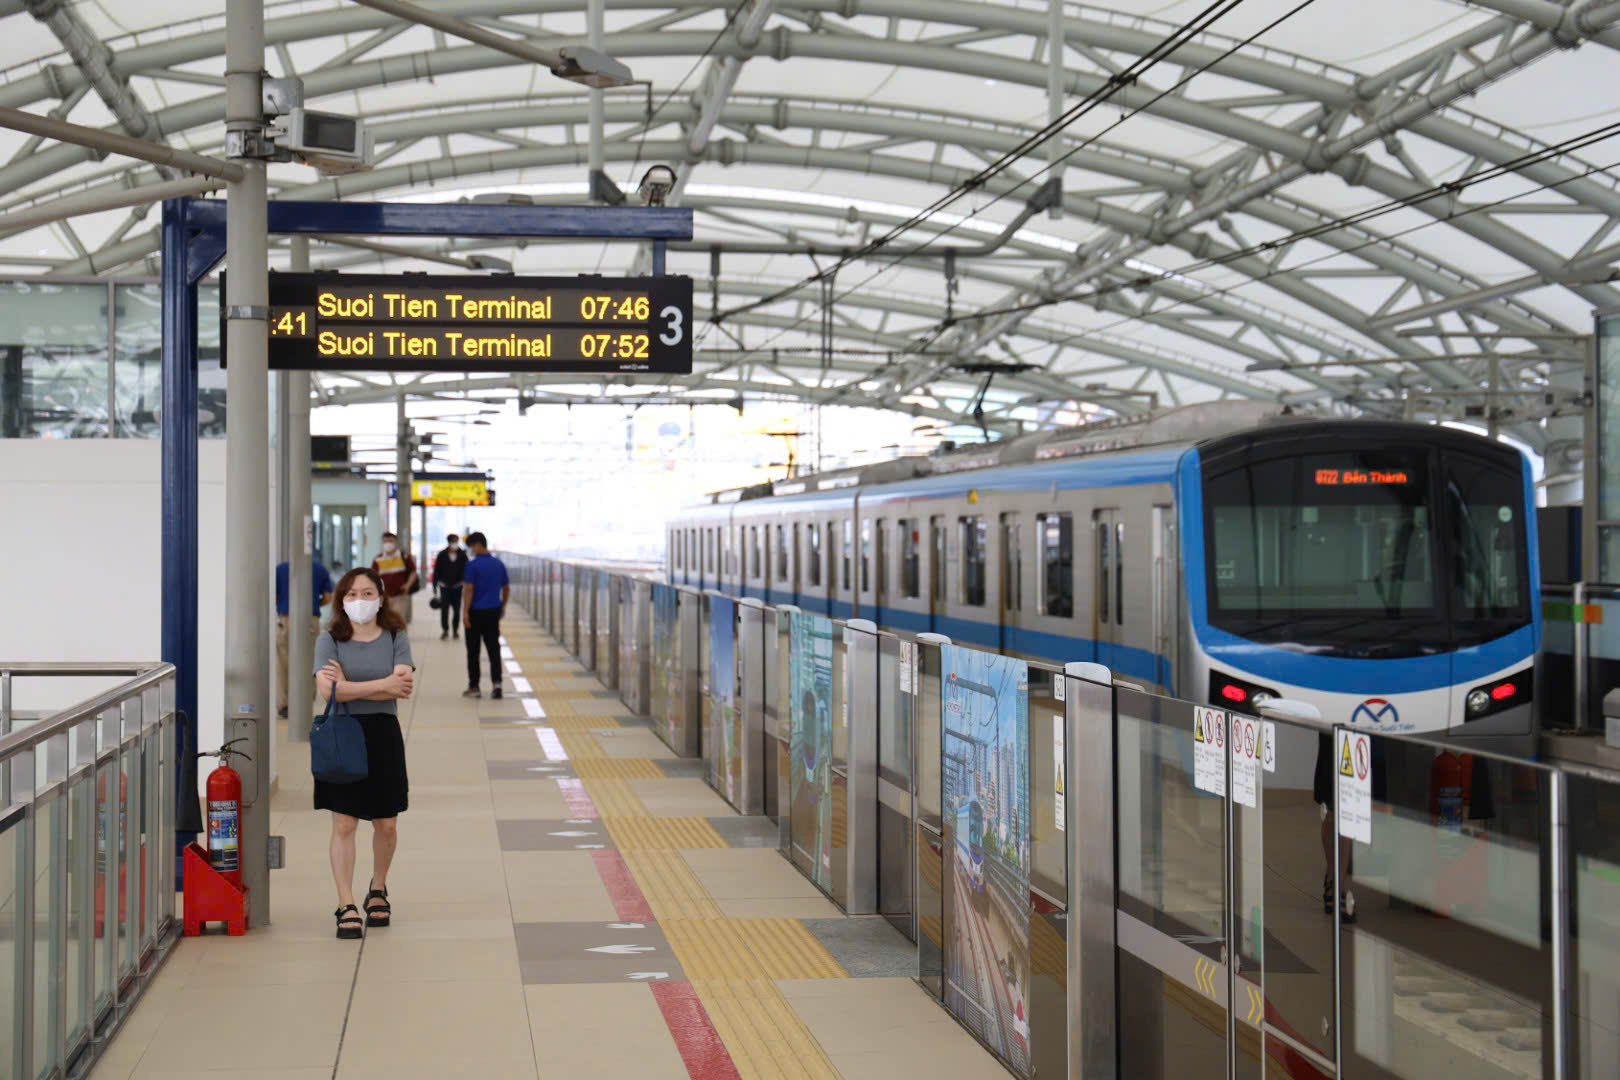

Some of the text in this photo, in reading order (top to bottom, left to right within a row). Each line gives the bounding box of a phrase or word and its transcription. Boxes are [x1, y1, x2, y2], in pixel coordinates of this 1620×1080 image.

[317, 292, 650, 320] Suoi Tien Terminal 07:46
[659, 305, 683, 346] 3
[317, 331, 650, 358] Suoi Tien Terminal 07:52
